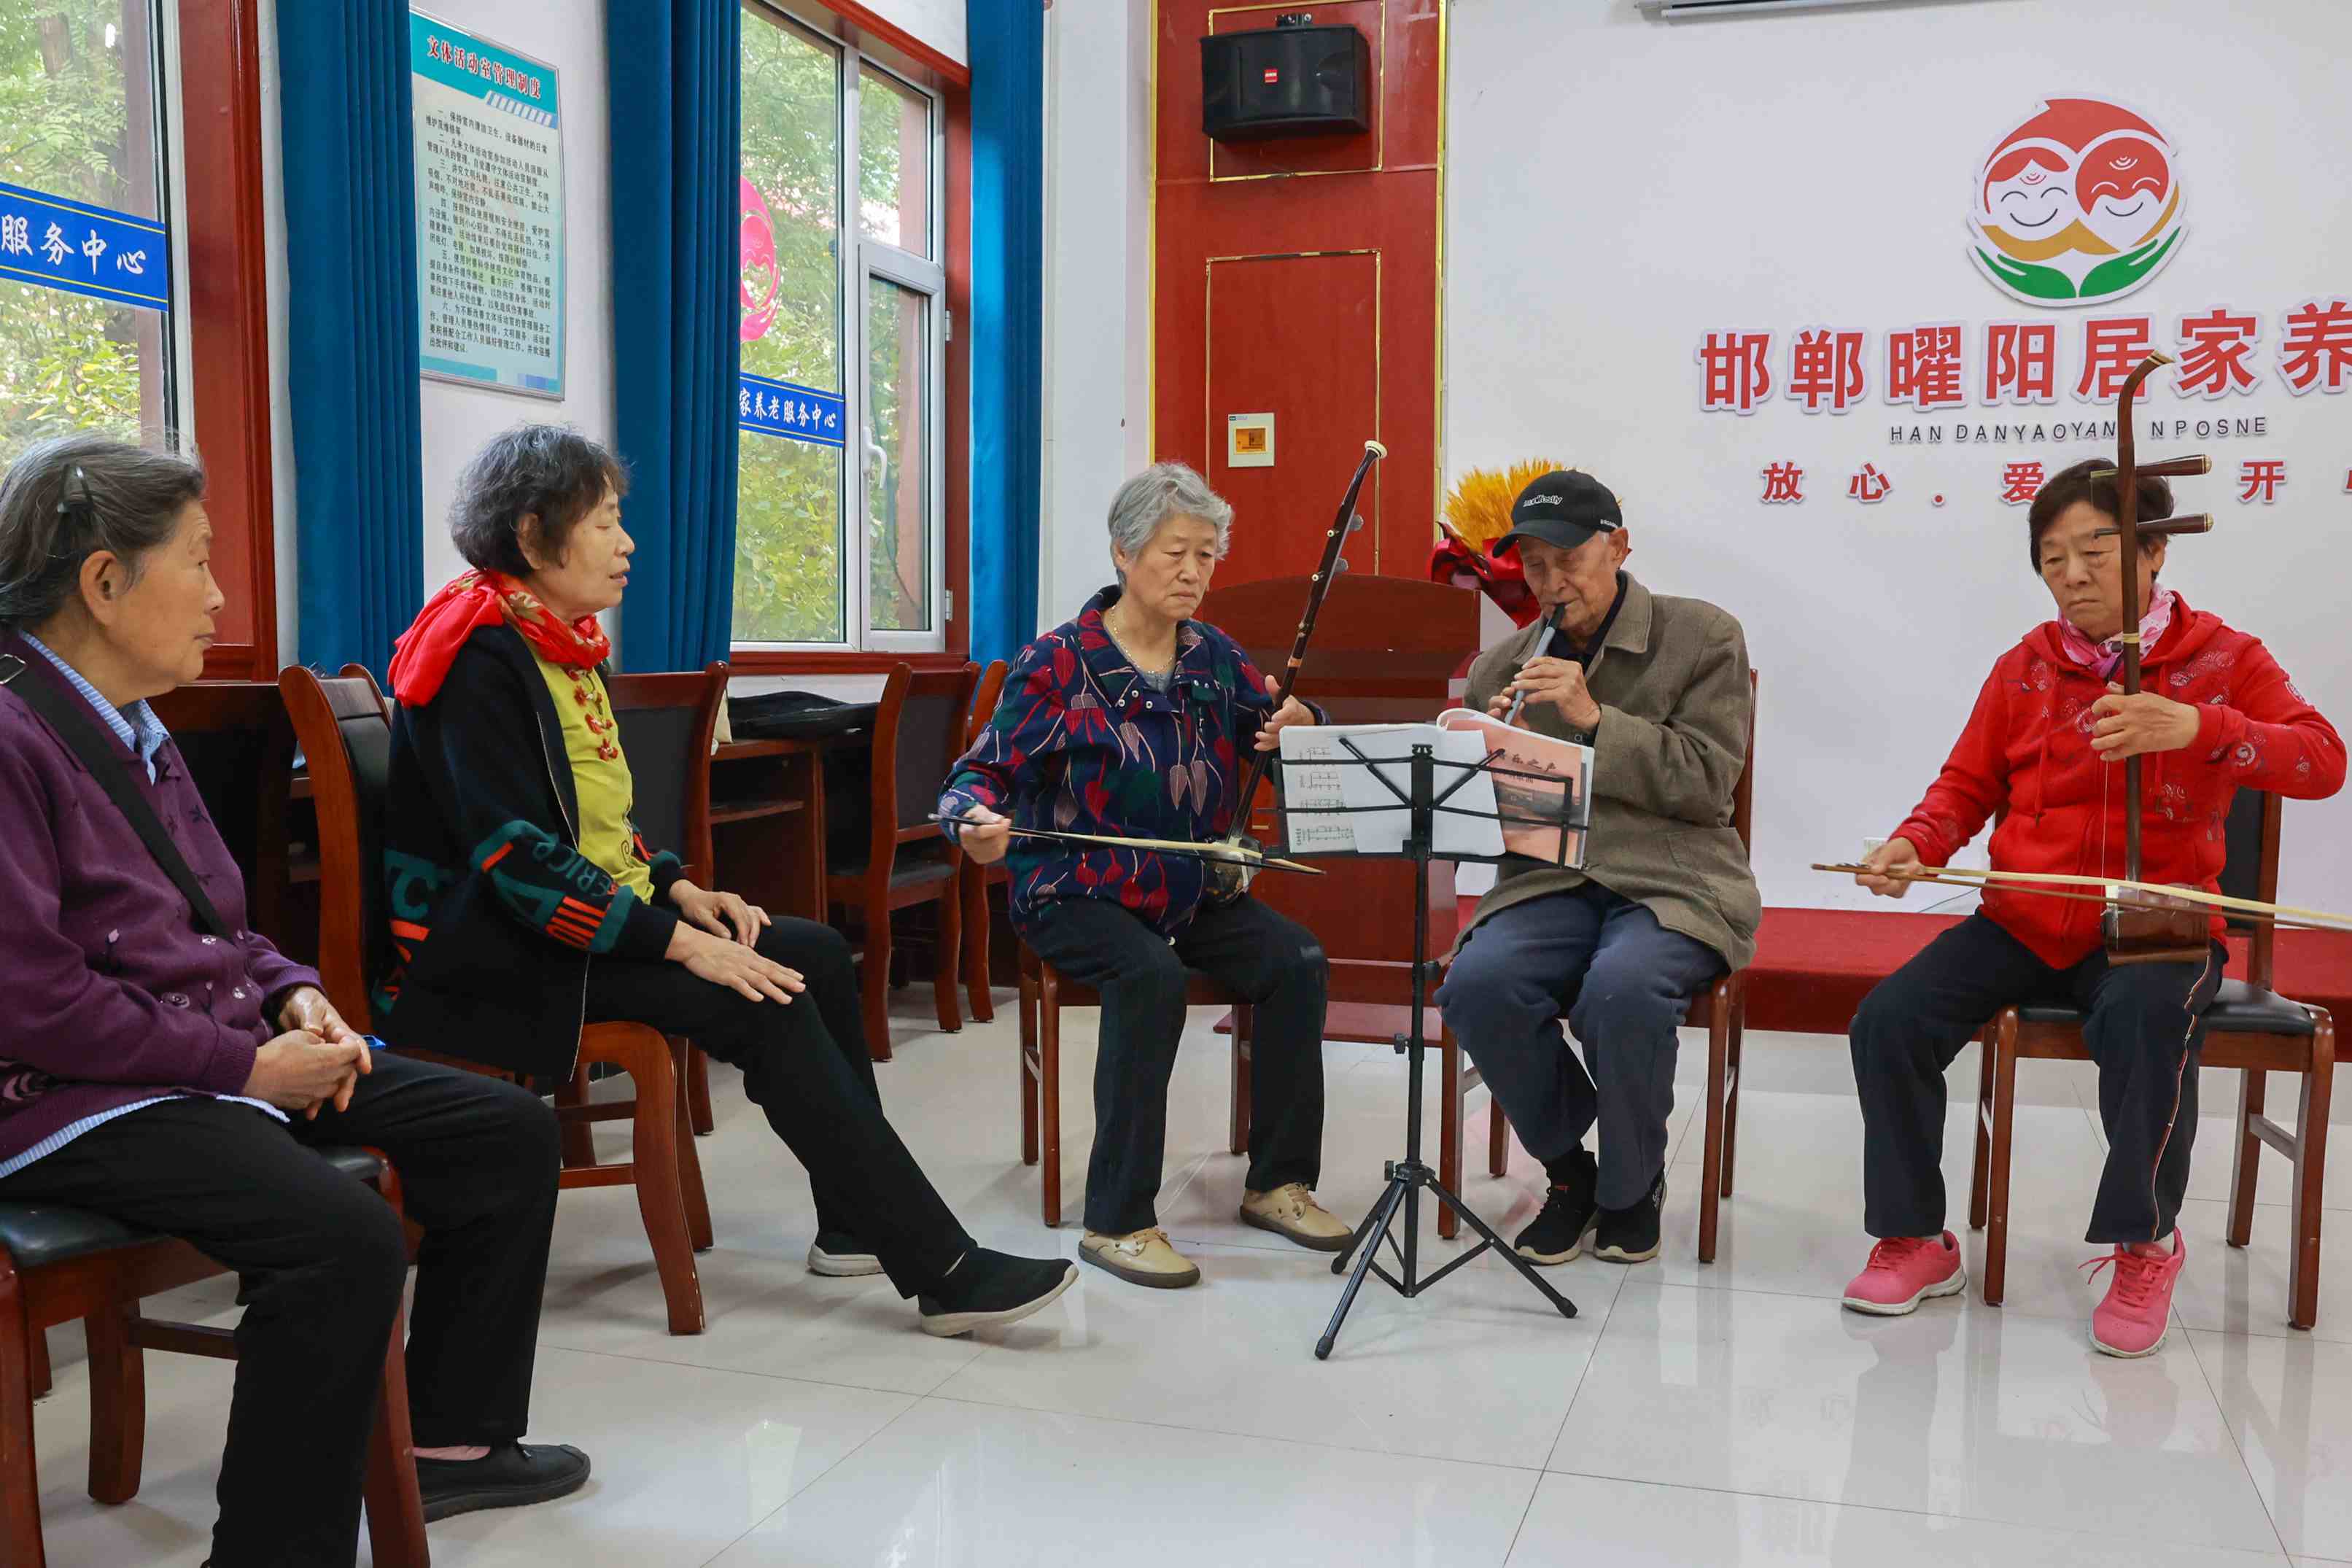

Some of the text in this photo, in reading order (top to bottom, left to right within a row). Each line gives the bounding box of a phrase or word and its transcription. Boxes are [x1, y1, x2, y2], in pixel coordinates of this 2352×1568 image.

[427, 36, 541, 99] 文体活动室管理制度
[1, 214, 147, 276] 服务中心
[739, 387, 837, 430] 家养老服务中心
[1890, 426, 1943, 442] HAN
